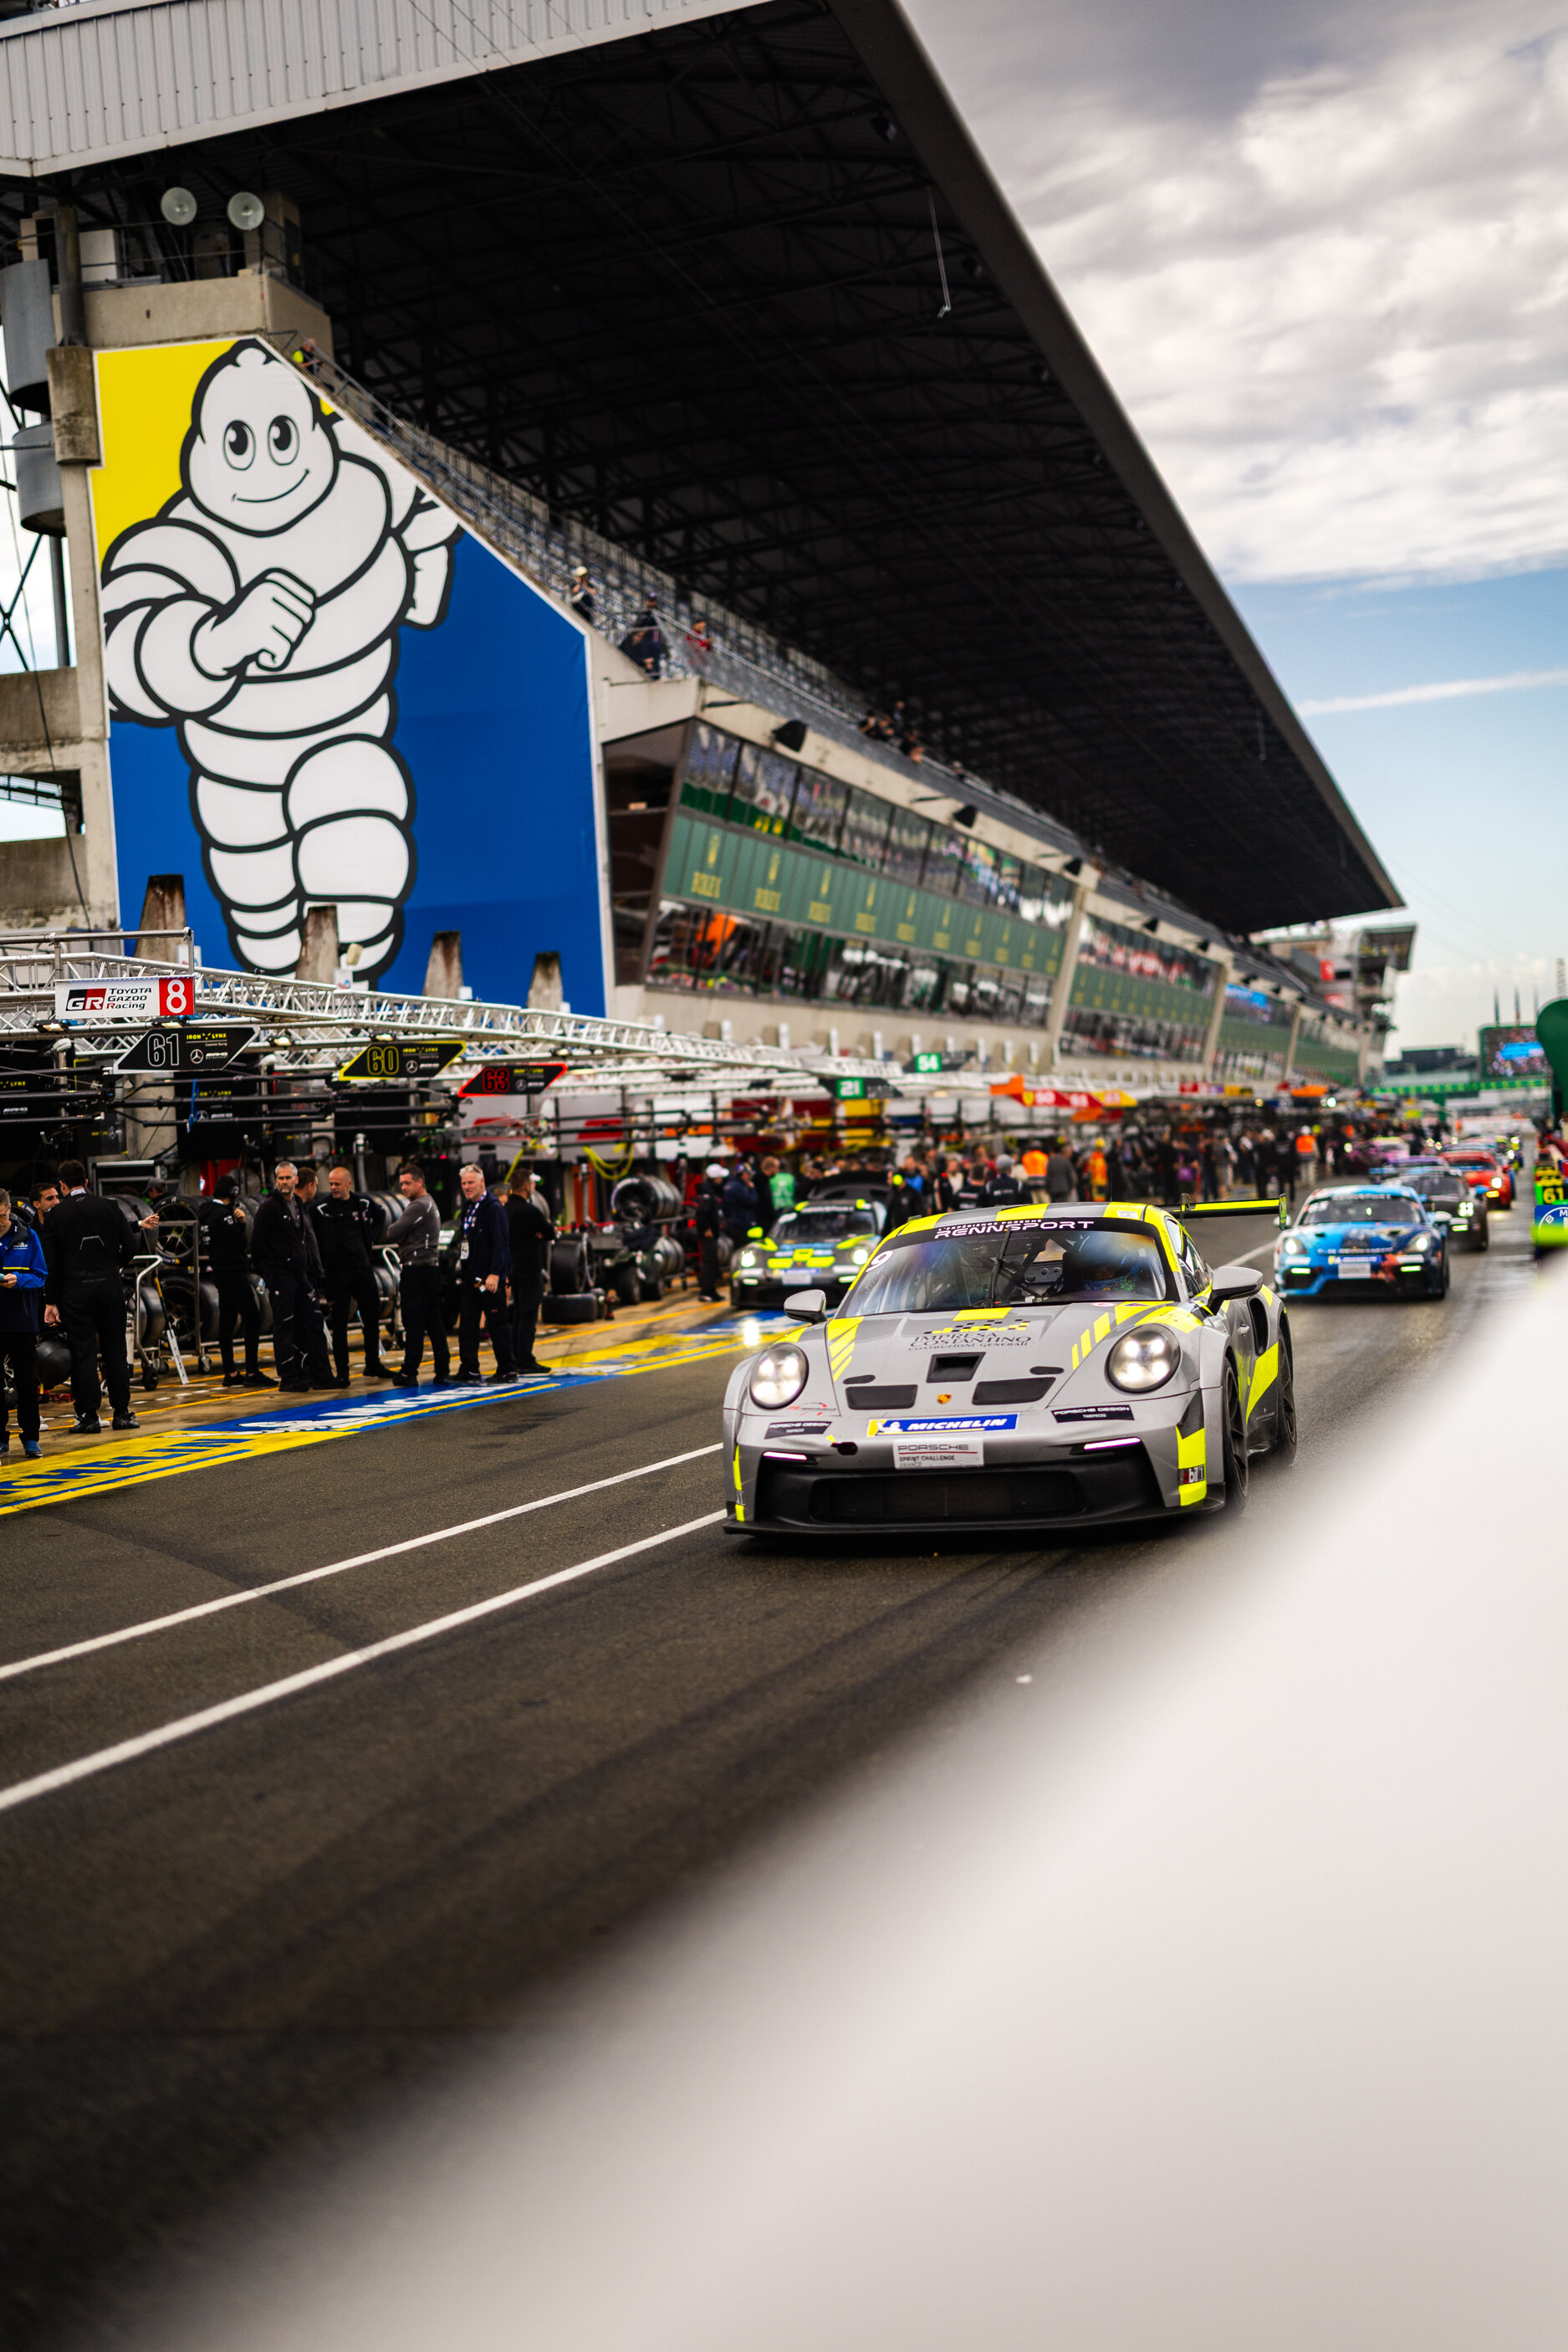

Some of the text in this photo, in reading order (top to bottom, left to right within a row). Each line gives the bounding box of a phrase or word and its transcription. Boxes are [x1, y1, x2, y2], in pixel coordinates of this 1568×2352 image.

[66, 996, 104, 1011] GR
[166, 979, 186, 1014] 8
[106, 1002, 146, 1010] Racing
[147, 1033, 180, 1067] 61
[366, 1046, 400, 1076] 60
[918, 1055, 938, 1071] 54
[482, 1067, 509, 1092] 63
[840, 1080, 860, 1097] 21
[1543, 1187, 1564, 1204] 61
[934, 1220, 1095, 1240] RENNSPORT
[865, 1250, 893, 1272] 9
[910, 1336, 1032, 1347] COSTANTINO
[914, 1332, 998, 1342] IMPRESA
[907, 1417, 1008, 1431] MICHELIN
